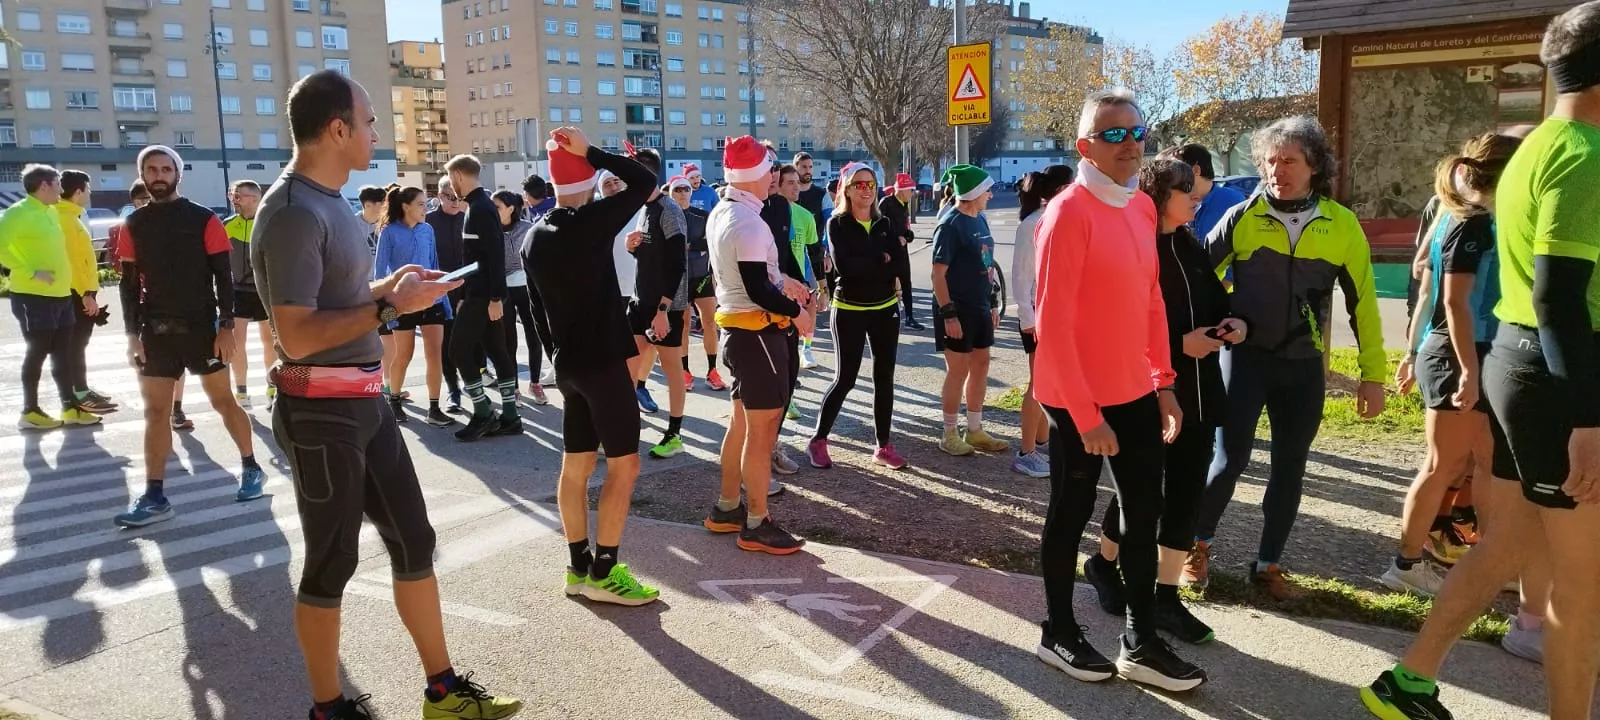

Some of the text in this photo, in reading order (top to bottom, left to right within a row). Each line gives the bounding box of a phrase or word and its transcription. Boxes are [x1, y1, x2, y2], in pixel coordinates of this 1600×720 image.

[1352, 44, 1384, 53] Camino
[1386, 41, 1418, 50] Natural
[1421, 40, 1432, 48] de
[1434, 38, 1464, 47] Loreto
[1475, 35, 1489, 44] del
[952, 112, 987, 121] CICLABLE
[1054, 643, 1075, 664] HOKA
